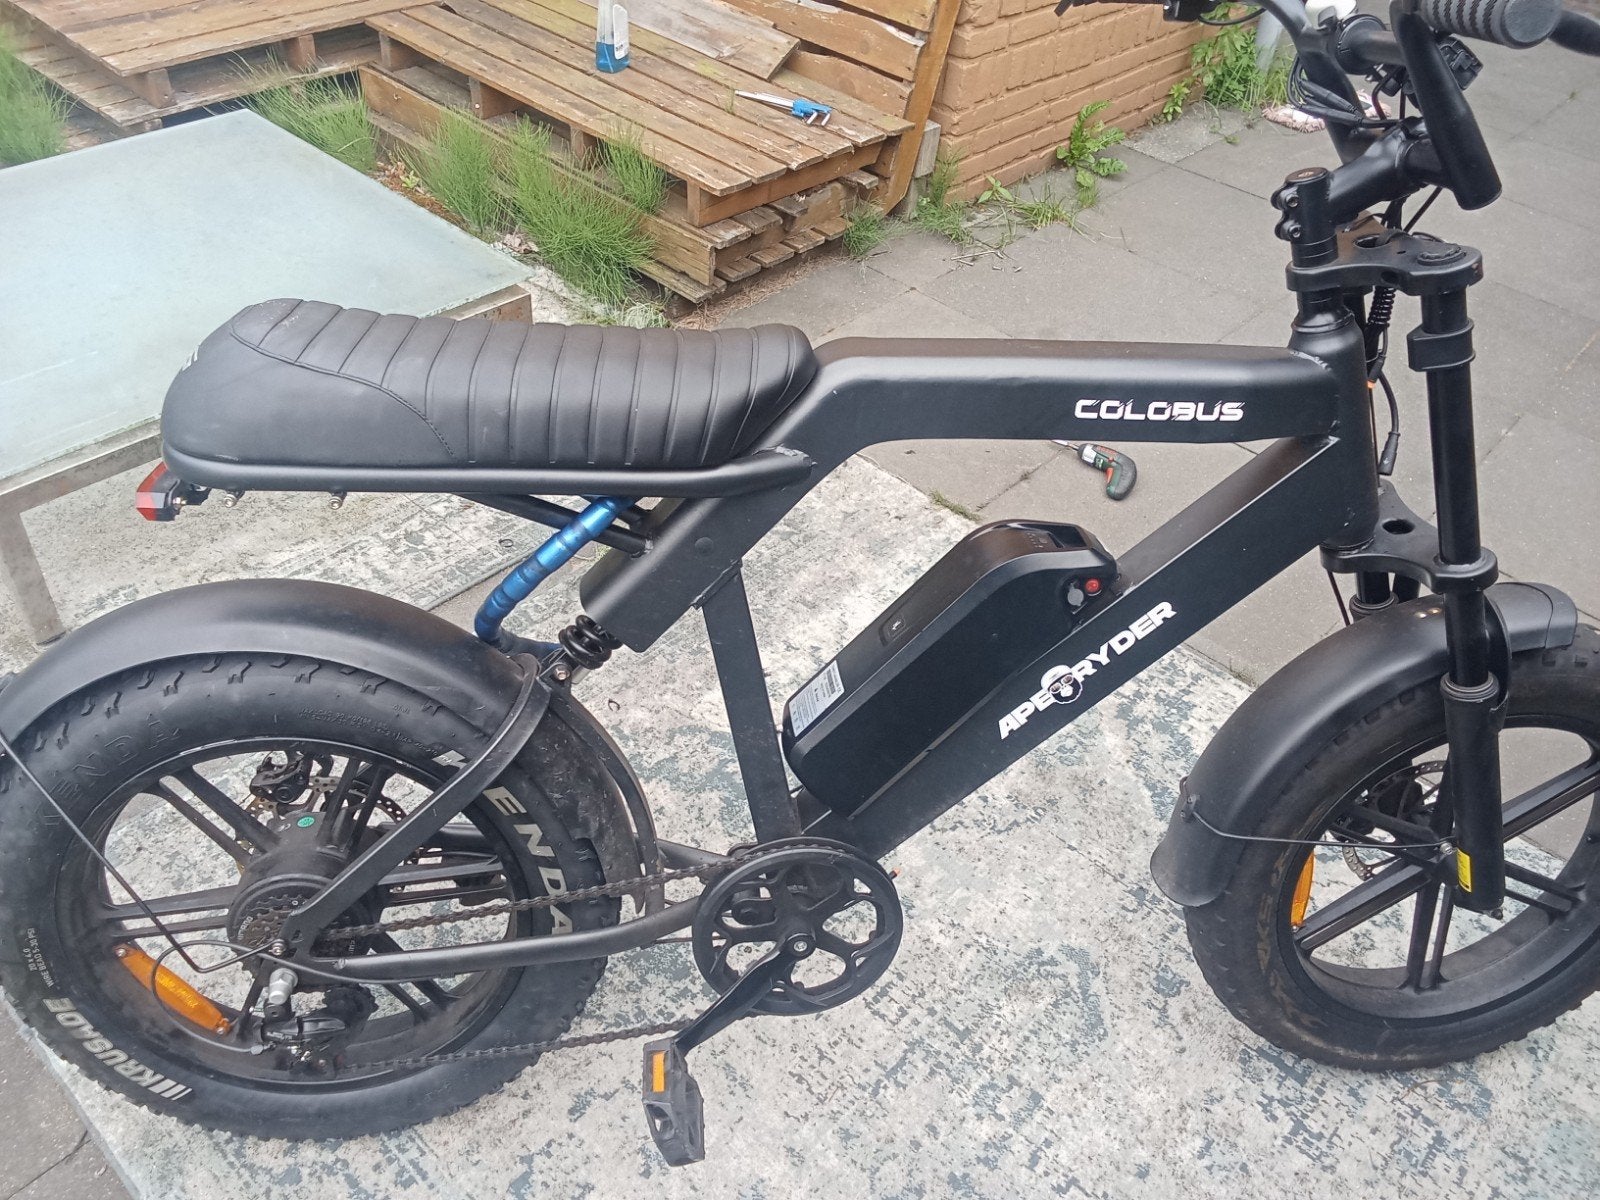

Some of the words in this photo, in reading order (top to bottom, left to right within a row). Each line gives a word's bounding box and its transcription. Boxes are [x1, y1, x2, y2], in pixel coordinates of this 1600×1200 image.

[1074, 399, 1246, 422] COLOBUS
[1070, 601, 1177, 683] RYDER
[33, 953, 47, 971] BEAD
[43, 998, 164, 1088] KRUSADE
